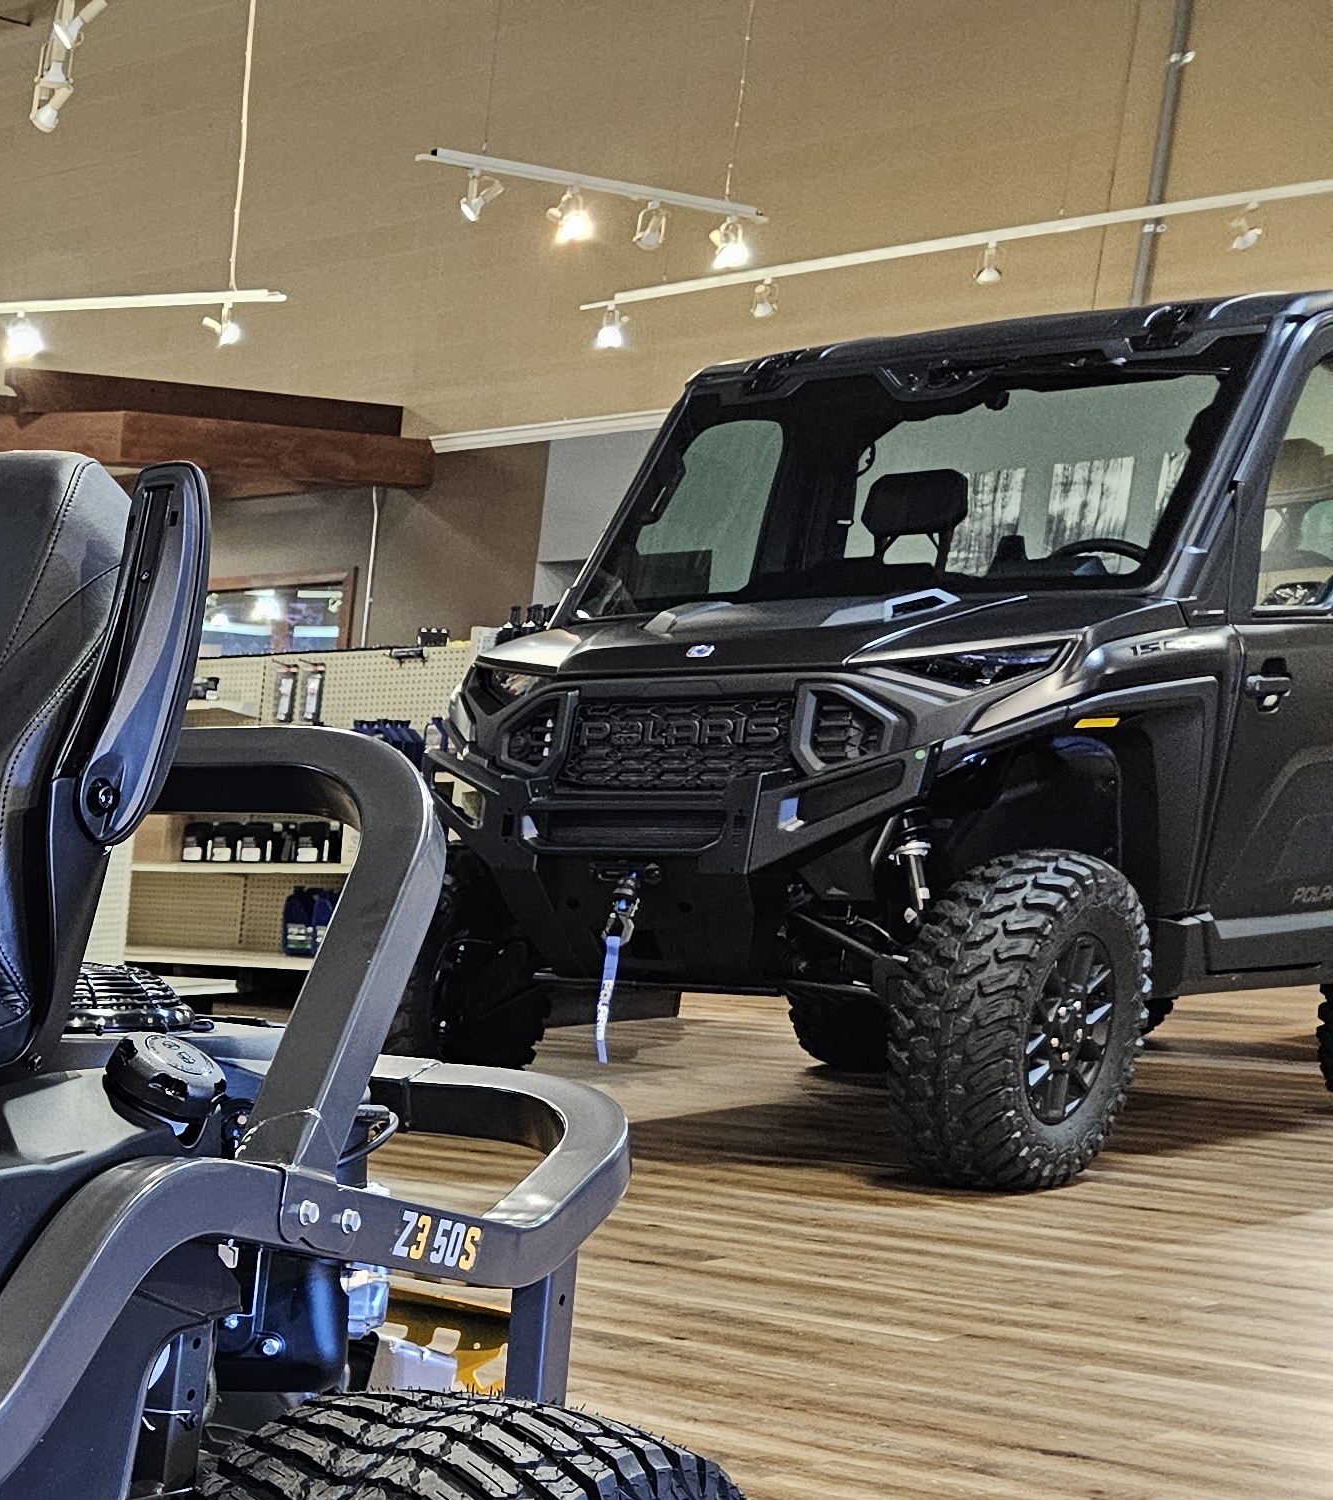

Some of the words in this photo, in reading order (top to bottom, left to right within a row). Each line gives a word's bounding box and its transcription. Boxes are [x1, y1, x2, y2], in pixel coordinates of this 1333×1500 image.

[579, 717, 780, 746] POLARIS
[1292, 885, 1333, 903] POLA
[392, 1210, 432, 1260] Z3
[429, 1218, 482, 1271] 50S
